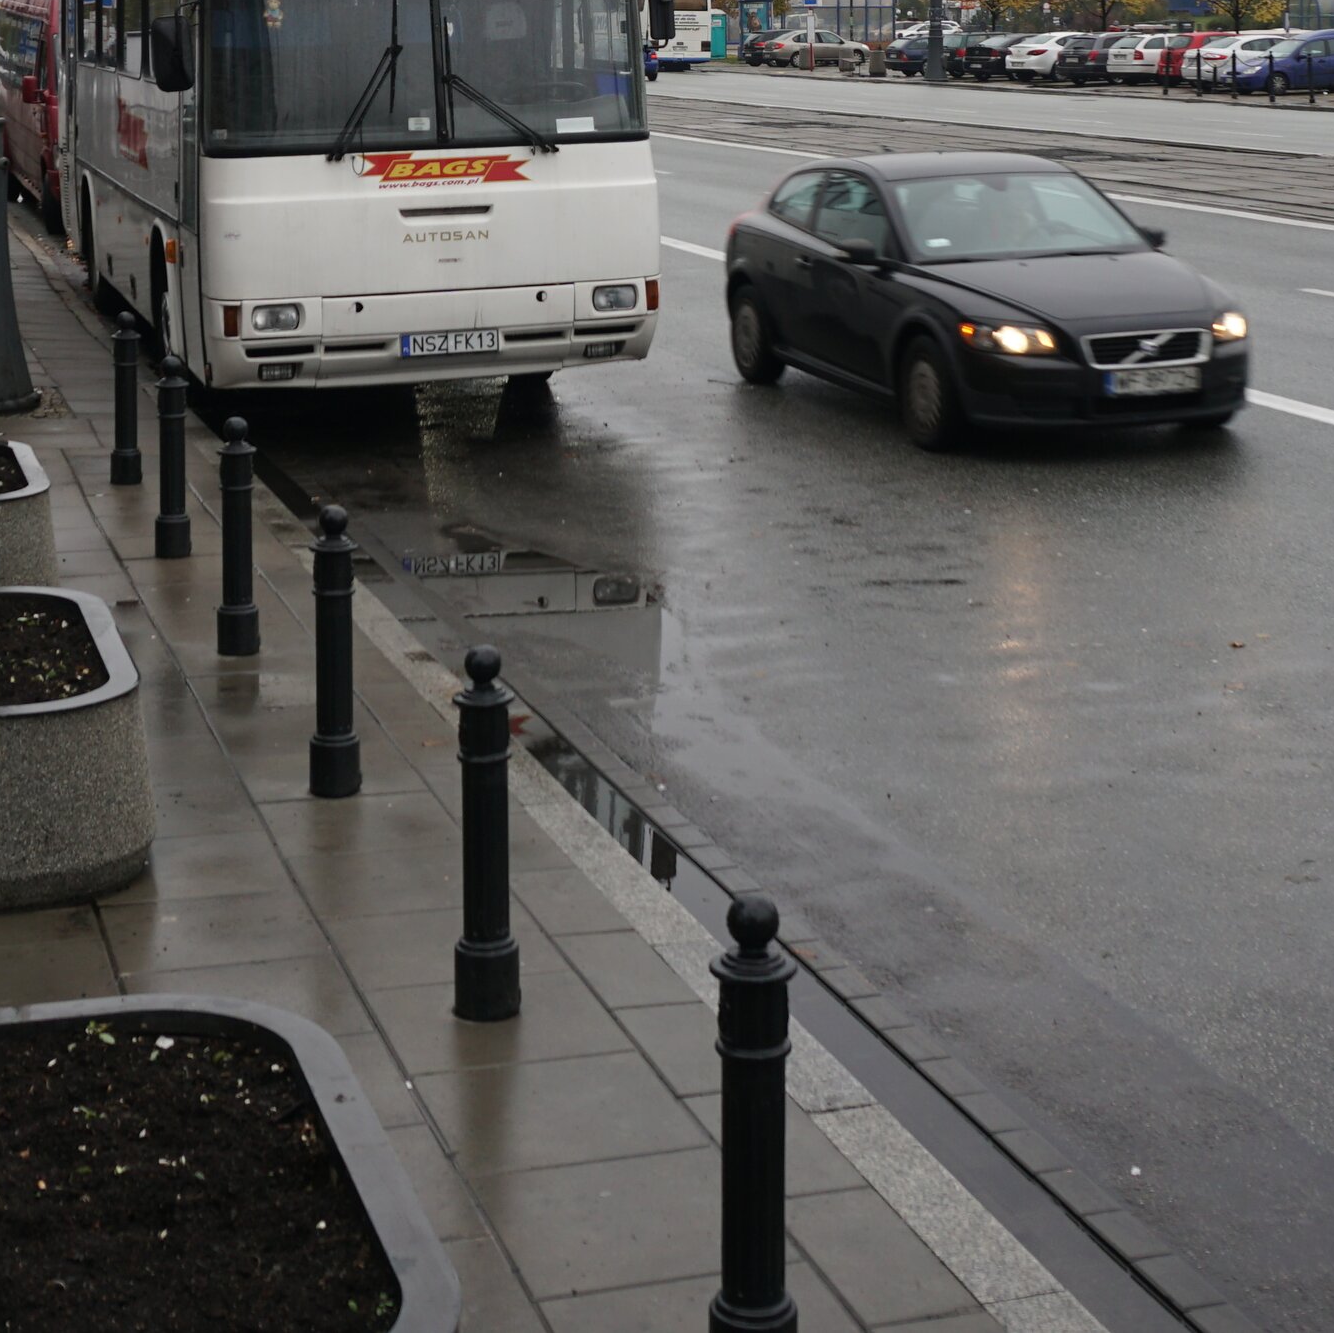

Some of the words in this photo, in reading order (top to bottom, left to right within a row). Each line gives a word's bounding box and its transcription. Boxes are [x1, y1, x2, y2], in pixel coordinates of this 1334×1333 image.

[388, 159, 493, 179] BAGS
[378, 177, 481, 190] www.bags.com.pl
[402, 229, 490, 244] AUTOSAN
[412, 335, 448, 353] NSZ
[454, 331, 496, 350] FK13
